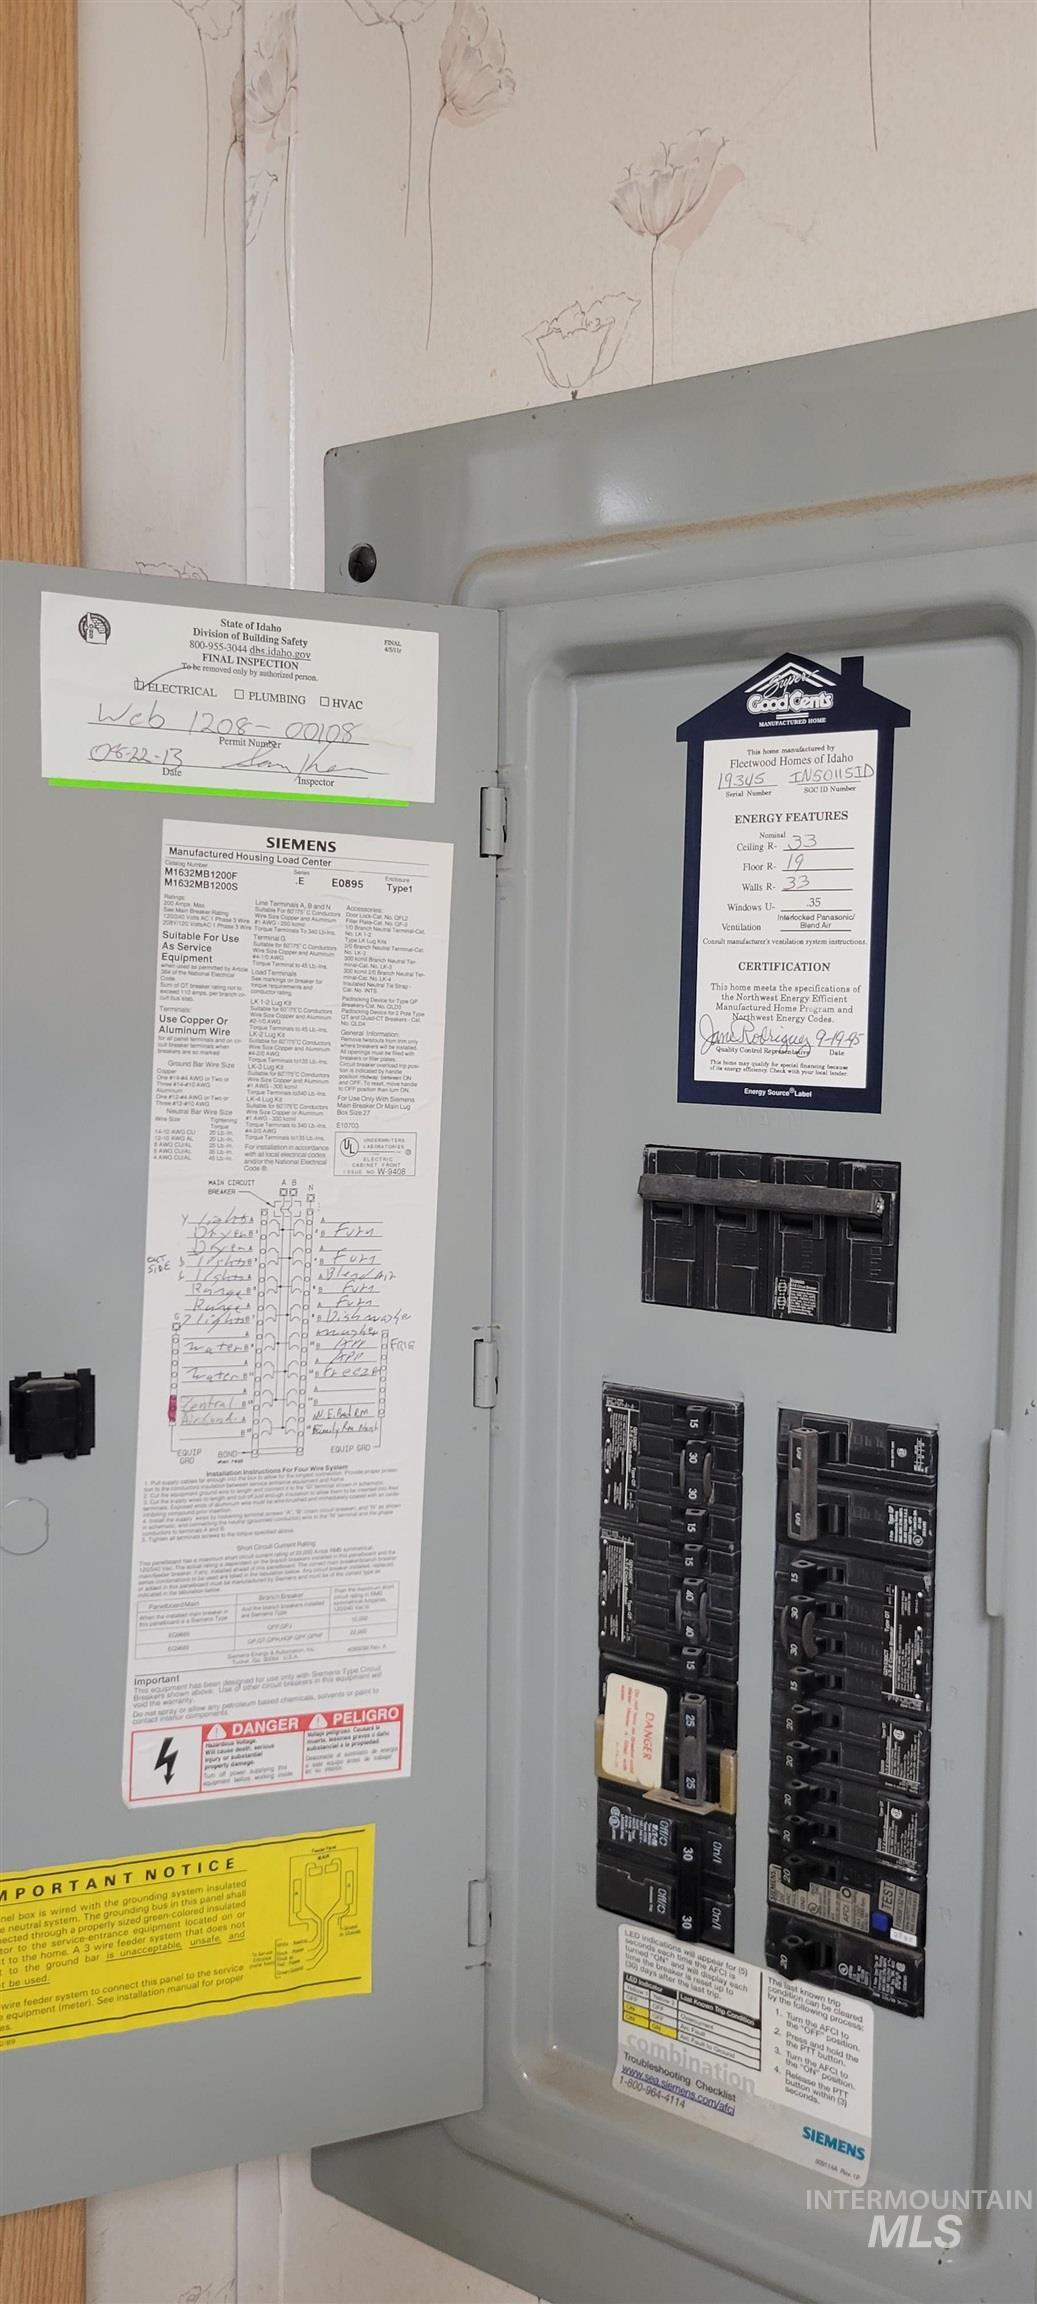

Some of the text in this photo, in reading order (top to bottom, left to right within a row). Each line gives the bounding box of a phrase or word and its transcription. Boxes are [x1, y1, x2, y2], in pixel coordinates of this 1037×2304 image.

[219, 617, 281, 632] State of Idaho
[192, 627, 308, 649] Division of Building Safety
[189, 639, 311, 661] 800-955-3044 dbs.idaho.gov
[201, 652, 298, 670] FINAL INSPECTION
[202, 665, 230, 673] removed
[229, 666, 247, 676] only
[248, 668, 257, 677] by
[258, 670, 293, 679] authorized
[147, 681, 217, 697] ELECTRICAL
[248, 691, 305, 704] PLUMBING
[332, 698, 363, 710] HVAC
[747, 688, 834, 715] Good Cents
[759, 718, 807, 727] MANUFACTURED
[218, 735, 246, 746] Permit
[781, 744, 825, 754] manufactured
[729, 752, 853, 768] Fleetwood Homes of Idaho
[162, 766, 182, 776] Date
[296, 775, 335, 787] Inspector
[829, 784, 856, 792] Number
[734, 810, 848, 824] ENERGY FEATURES
[265, 836, 336, 853] SIEMENS
[736, 842, 764, 852] Ceiling
[168, 846, 332, 867] Manufactured Housing Load Center
[164, 866, 237, 880] M1632MB1200F
[742, 862, 763, 871] Floor
[164, 877, 238, 891] M1632MB1200S
[331, 877, 363, 888] E0895
[741, 882, 763, 891] Walls
[727, 903, 761, 911] Windows
[721, 922, 761, 931] Ventilation
[161, 930, 239, 942] Suitable For Use
[160, 940, 211, 952] As Service
[160, 951, 212, 963] Equipment
[737, 961, 831, 971] CERTIFICATION
[710, 982, 727, 990] This
[729, 983, 751, 991] home
[778, 983, 792, 992] the
[794, 983, 850, 993] specifications
[852, 984, 861, 992] of
[721, 992, 847, 1003] the Northwest Energy Efficient
[715, 1002, 853, 1014] Manufactured Home Program and
[158, 1013, 228, 1026] Use Copper Or
[731, 1012, 833, 1023] Northwest Energy Codes.
[157, 1024, 230, 1036] Aluminum Wire
[744, 1087, 766, 1096] Energy
[689, 1418, 699, 1429] 15
[688, 1452, 698, 1464] 30
[687, 1487, 698, 1500] 30
[687, 1522, 696, 1533] 15
[790, 1572, 799, 1583] 15
[685, 1589, 694, 1601] 40
[790, 1606, 799, 1619] 30
[685, 1625, 694, 1637] 40
[134, 1674, 179, 1686] Important
[333, 1707, 399, 1725] PELIGRO
[685, 1714, 696, 1727] 25
[232, 1717, 298, 1735] DANGER
[786, 1719, 794, 1731] 20
[643, 1711, 655, 1761] DANGER
[785, 1755, 793, 1767] 20
[685, 1776, 696, 1790] 25
[683, 1847, 694, 1861] 30
[145, 1857, 234, 1880] NOTICE
[784, 1869, 791, 1883] 20
[18, 1912, 34, 1920] box
[50, 1904, 76, 1915] wired
[79, 1901, 100, 1910] with
[104, 1899, 118, 1907] the
[122, 1892, 167, 1906] grounding
[171, 1887, 202, 1897] system
[206, 1880, 246, 1893] insulated
[881, 1882, 895, 1909] TEST
[682, 1915, 693, 1929] 30
[780, 1954, 788, 1967] 20
[627, 2033, 756, 2093] combination
[623, 2051, 735, 2102] Troubleshooting Checklist
[619, 2075, 685, 2108] 1-800-964-4114
[620, 2064, 735, 2116] www.sea.siemens.com/afci
[801, 2126, 865, 2160] SIEMENS
